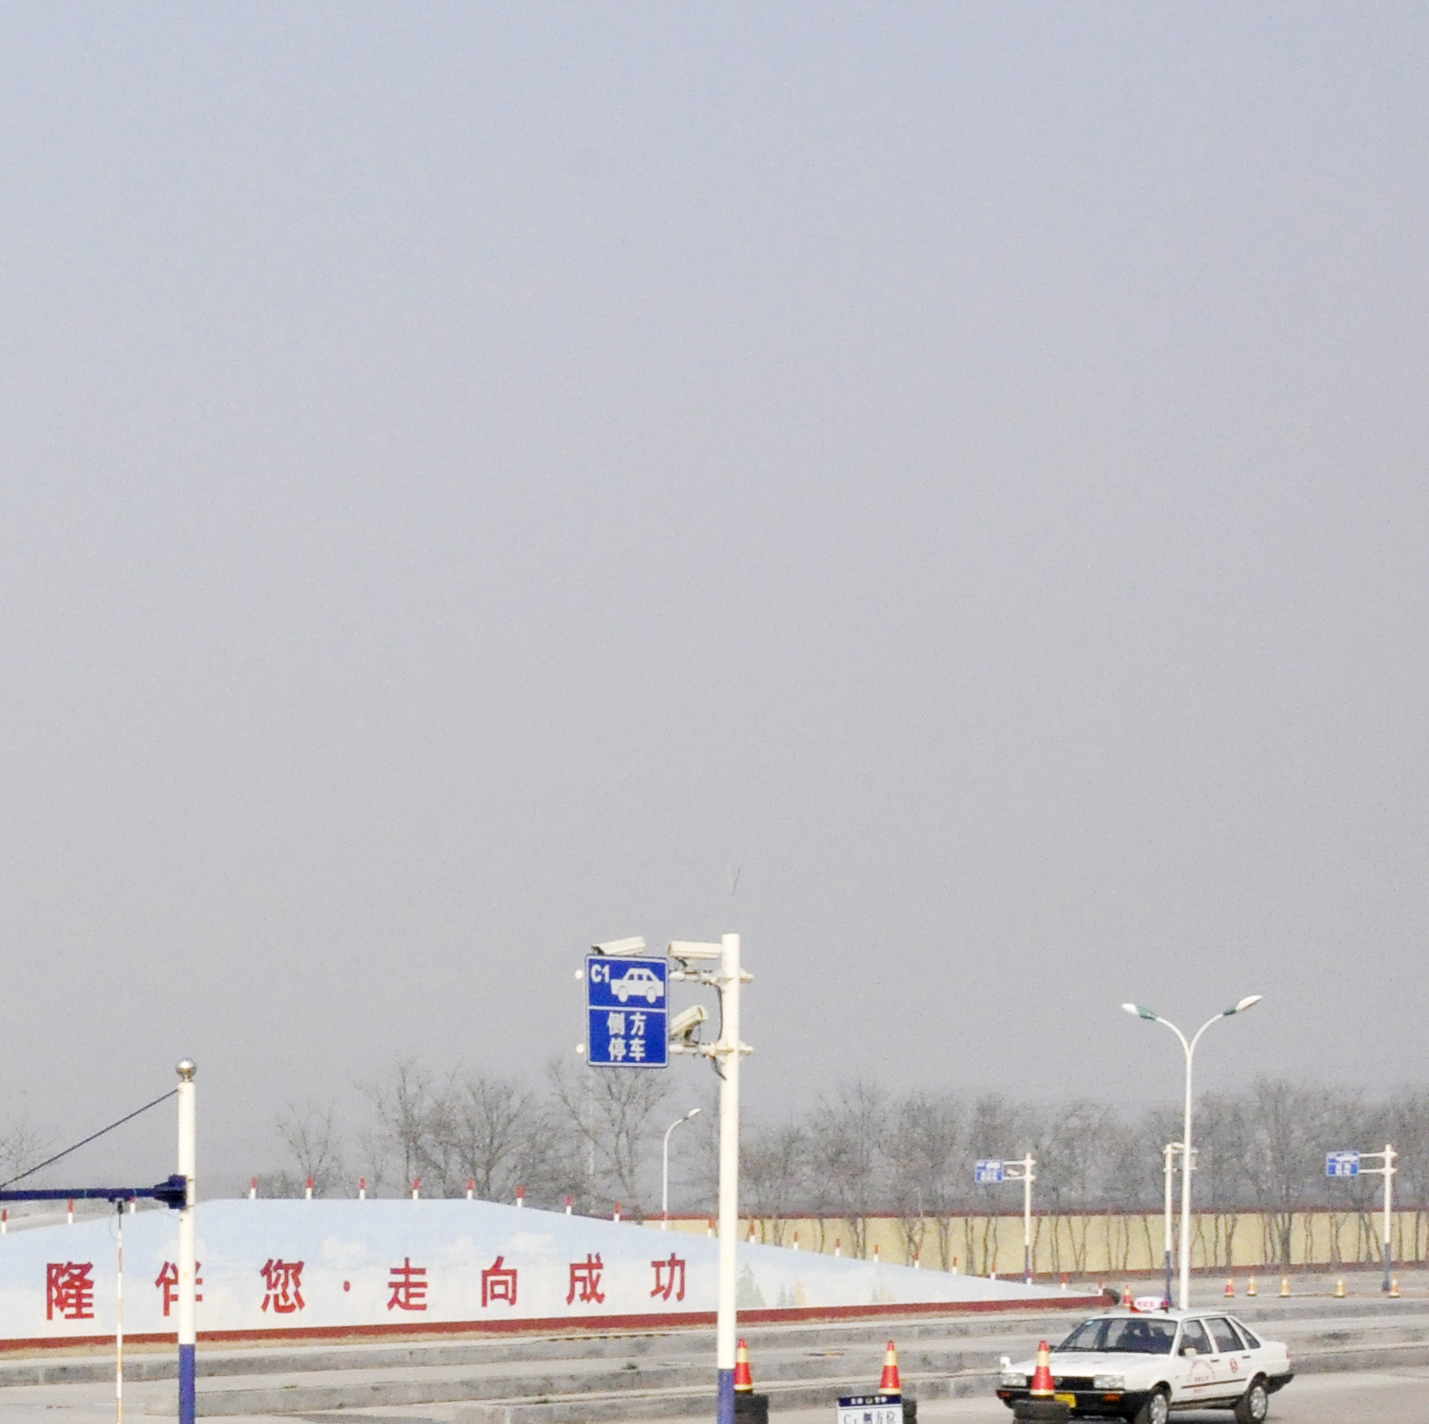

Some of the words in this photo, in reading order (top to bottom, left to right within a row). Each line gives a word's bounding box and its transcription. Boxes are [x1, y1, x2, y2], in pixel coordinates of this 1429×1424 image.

[591, 964, 610, 983] C1
[607, 1011, 647, 1036] 侧方
[608, 1037, 646, 1061] 停车
